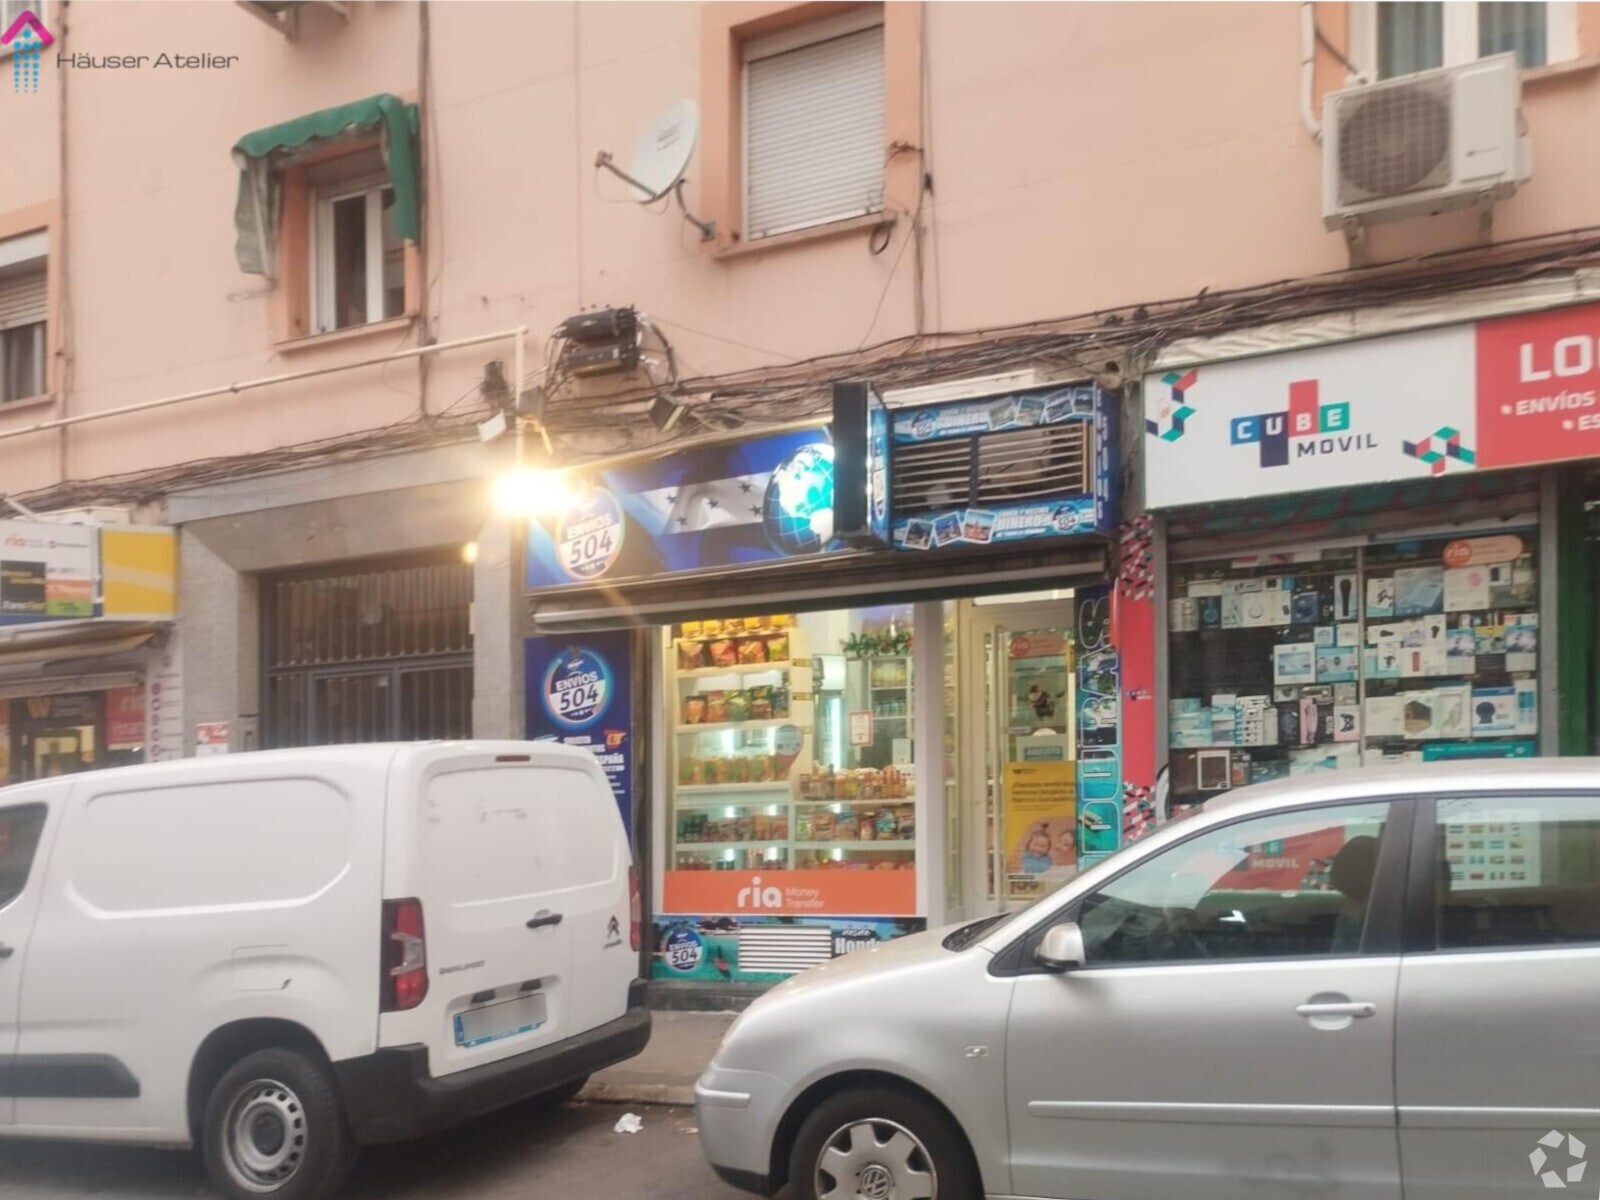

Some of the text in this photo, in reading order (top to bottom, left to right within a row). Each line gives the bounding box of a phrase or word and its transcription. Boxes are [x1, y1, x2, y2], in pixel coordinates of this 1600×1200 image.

[1519, 334, 1600, 384] LO
[1516, 390, 1596, 415] ENVÍOS
[1237, 408, 1343, 440] CUBE
[1296, 432, 1378, 458] MOVIL
[569, 528, 613, 565] 504
[1445, 543, 1470, 558] ria
[560, 684, 599, 711] 504
[1251, 857, 1300, 870] MOVIL
[737, 876, 820, 908] ria Money
[786, 898, 825, 909] Transfer
[672, 949, 698, 964] 504
